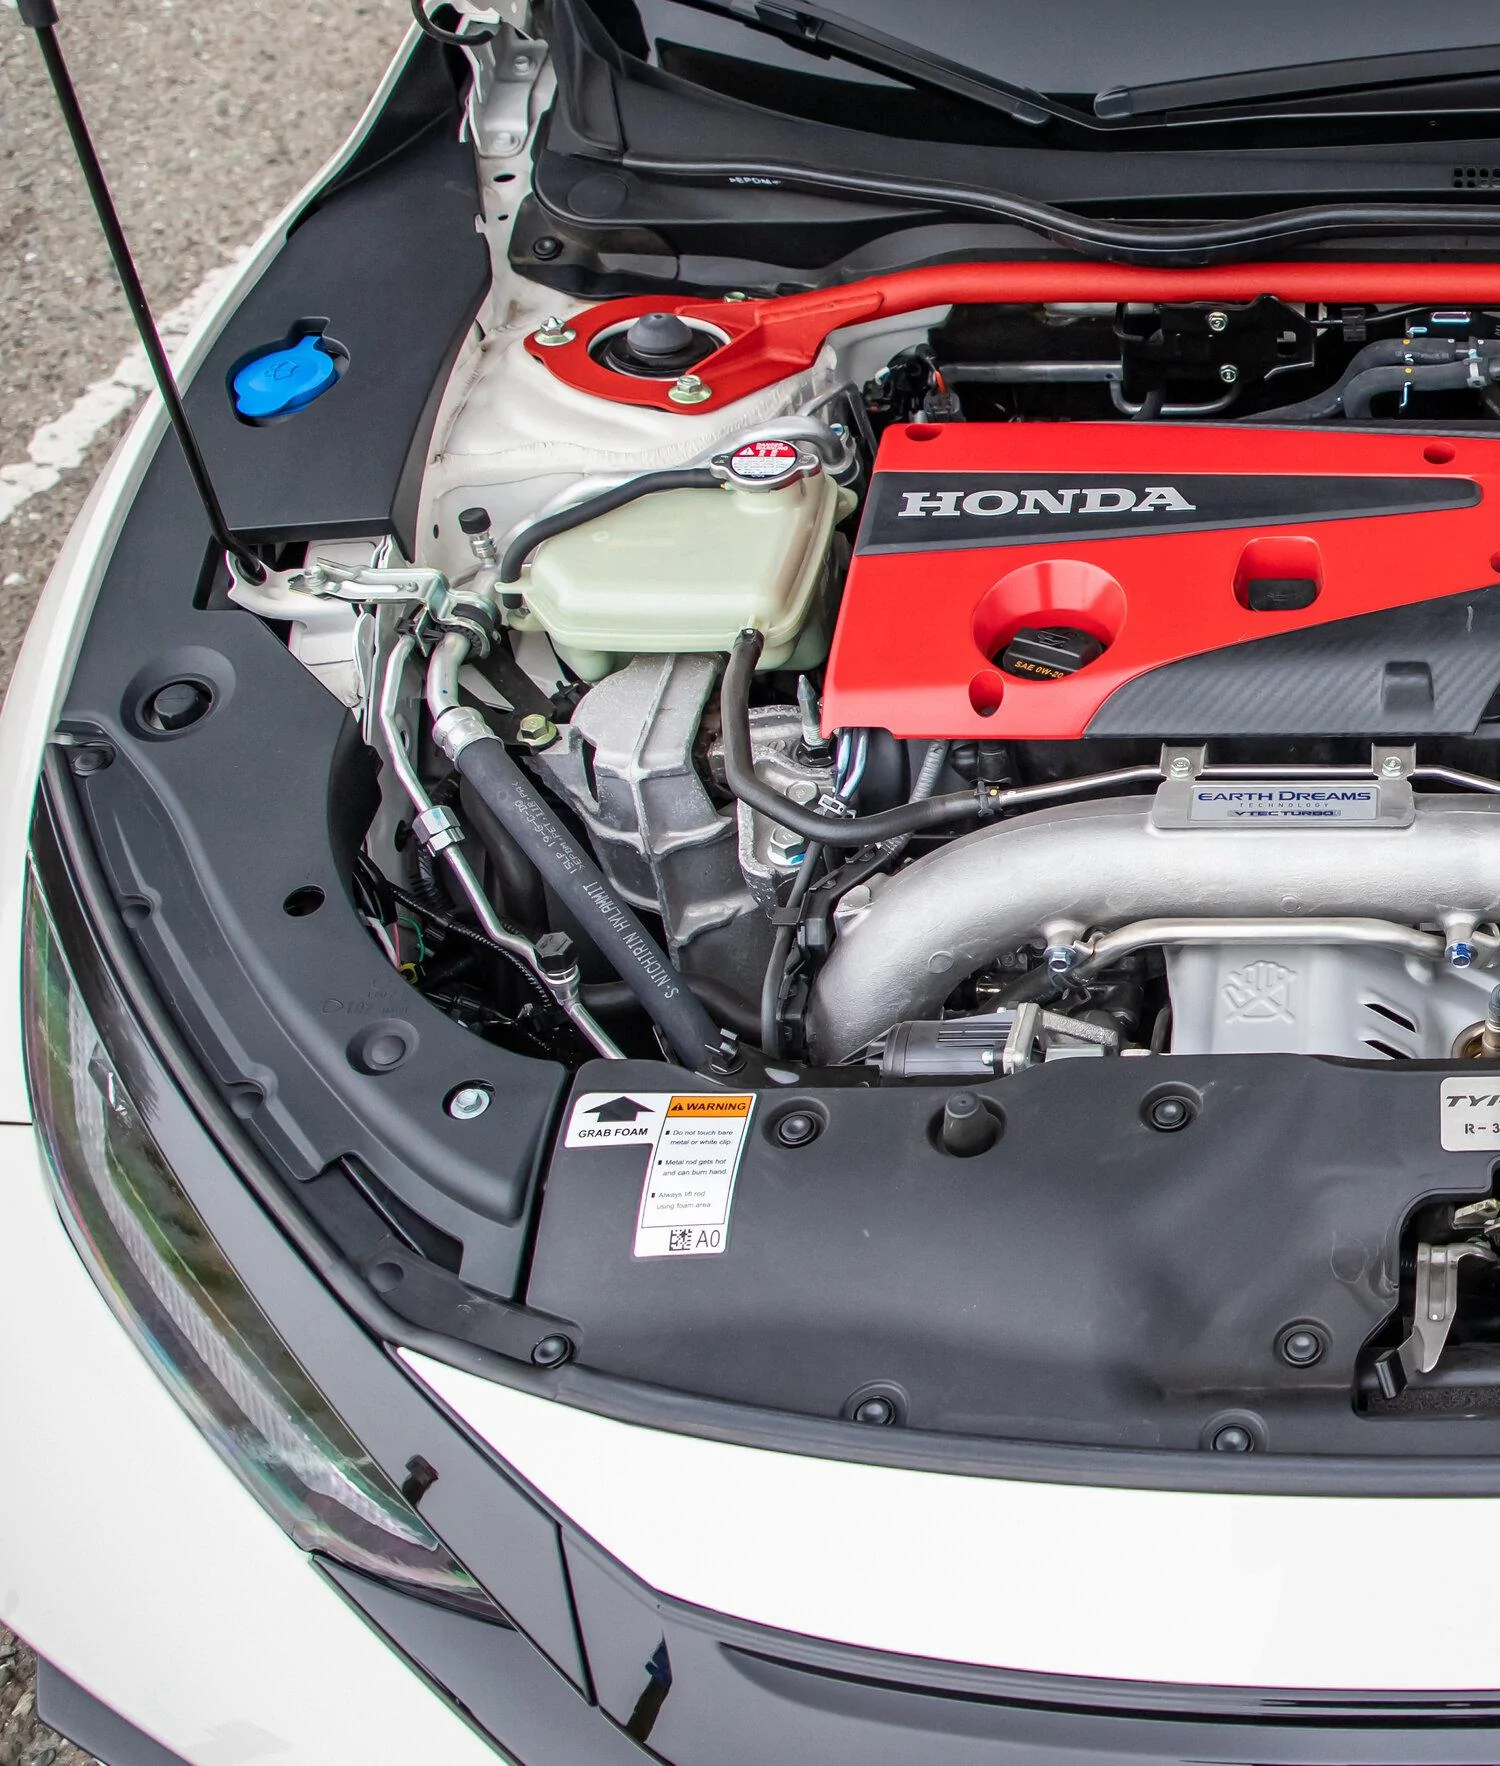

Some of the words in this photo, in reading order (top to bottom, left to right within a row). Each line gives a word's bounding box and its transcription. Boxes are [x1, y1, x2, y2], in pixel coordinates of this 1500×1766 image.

[898, 486, 1196, 517] HONDA
[1014, 660, 1035, 671] SAE
[1035, 666, 1064, 679] 0W-20
[1198, 792, 1273, 801] EARTH
[1278, 791, 1371, 801] DREAMS
[686, 1102, 747, 1111] WARNING
[578, 1129, 612, 1138] GRAB
[614, 1127, 649, 1136] FOAM
